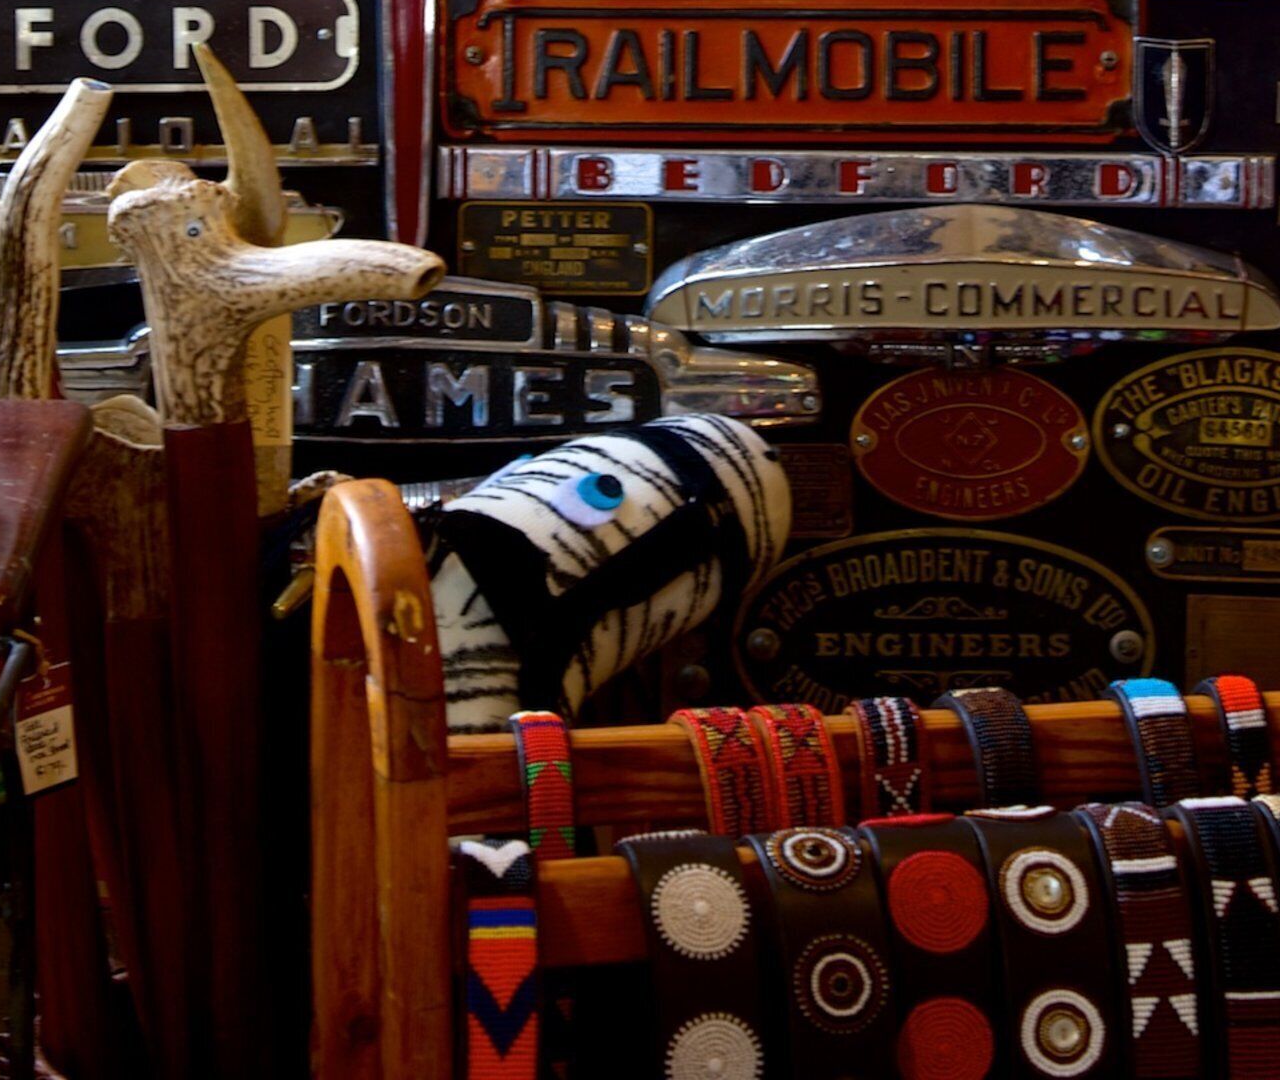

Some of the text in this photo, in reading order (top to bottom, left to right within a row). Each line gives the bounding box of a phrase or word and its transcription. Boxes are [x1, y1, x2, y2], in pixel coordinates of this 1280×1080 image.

[575, 158, 1138, 200] BEDFORD
[501, 210, 612, 229] PETTER
[320, 303, 492, 331] FORDSON
[1109, 375, 1165, 420] THE
[1165, 395, 1243, 426] CARTER'S
[1136, 464, 1187, 505] OIL
[825, 547, 994, 599] BROADBENT
[992, 558, 1012, 588] &
[1014, 557, 1091, 611] SONS
[814, 631, 1073, 658] ENGINEERS
